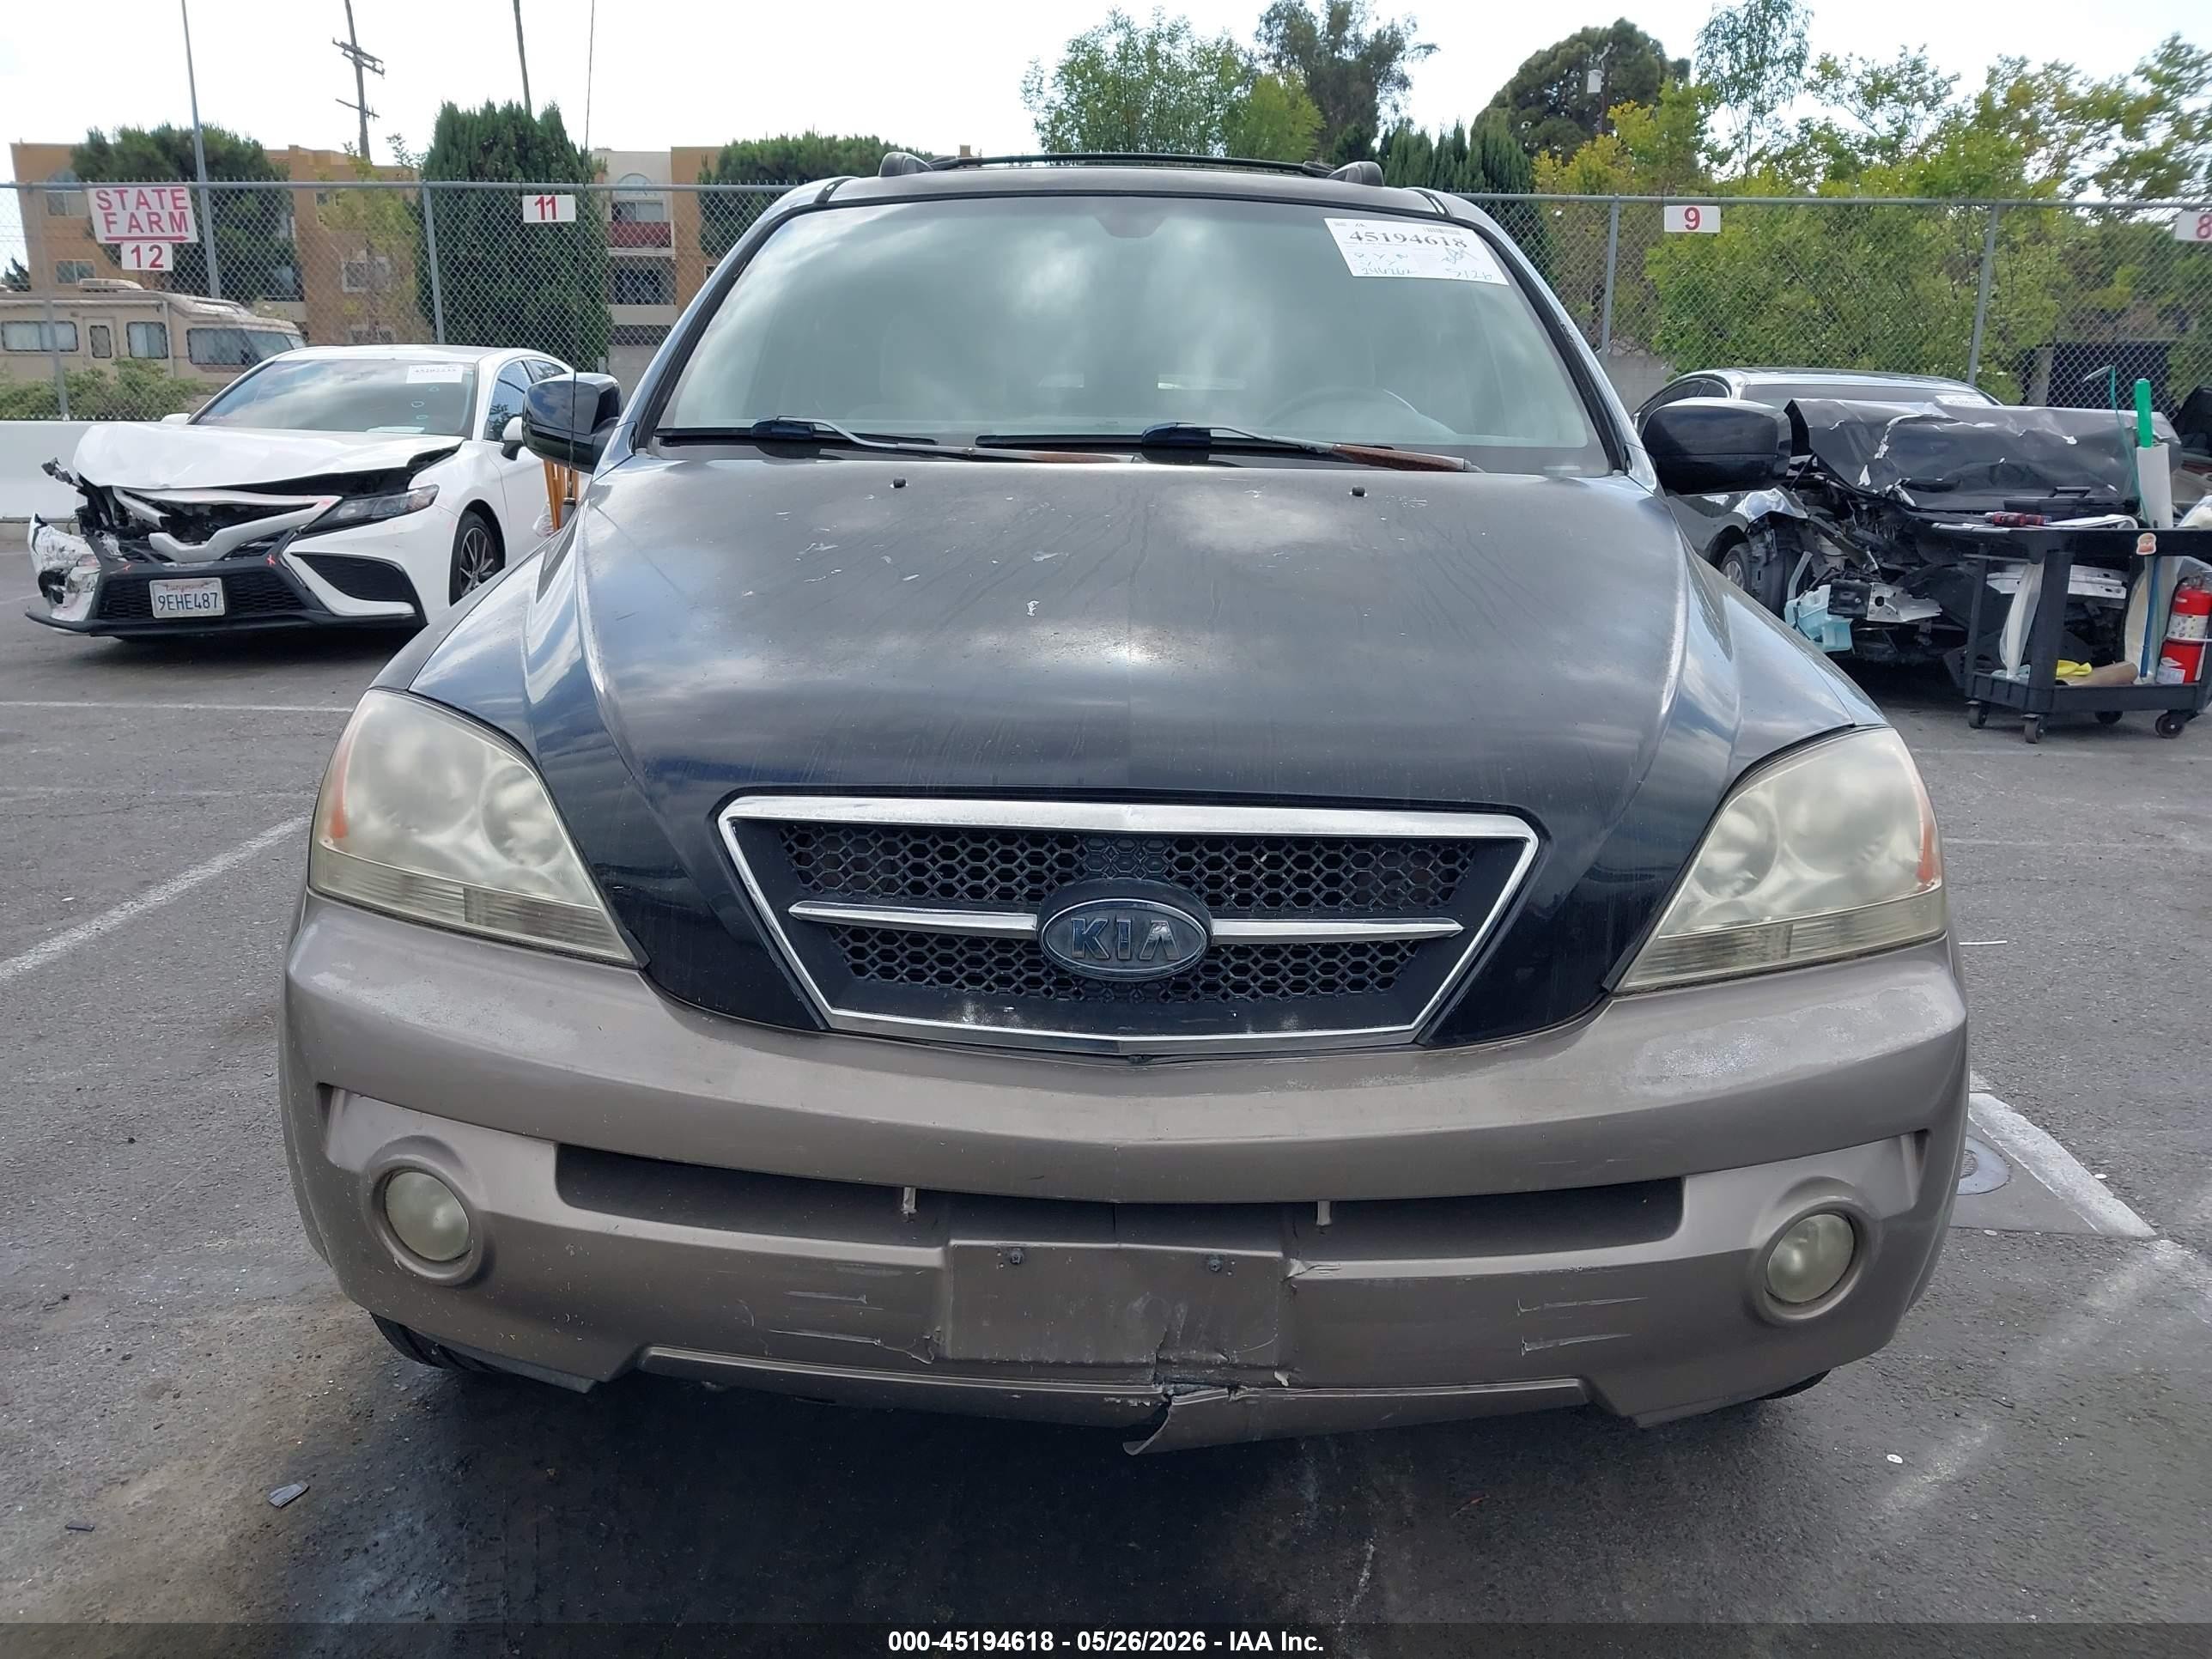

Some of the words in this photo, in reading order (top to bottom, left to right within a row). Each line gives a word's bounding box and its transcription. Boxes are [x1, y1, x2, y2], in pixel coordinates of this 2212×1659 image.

[96, 189, 188, 210] STATE
[534, 196, 557, 221] 11
[104, 211, 189, 234] FARM
[1684, 206, 1700, 230] 9
[2197, 213, 2212, 240] 8
[1349, 230, 1468, 248] 45194618
[131, 244, 164, 269] 12
[158, 592, 218, 611] 9EHE487
[1071, 917, 1182, 961] KIA
